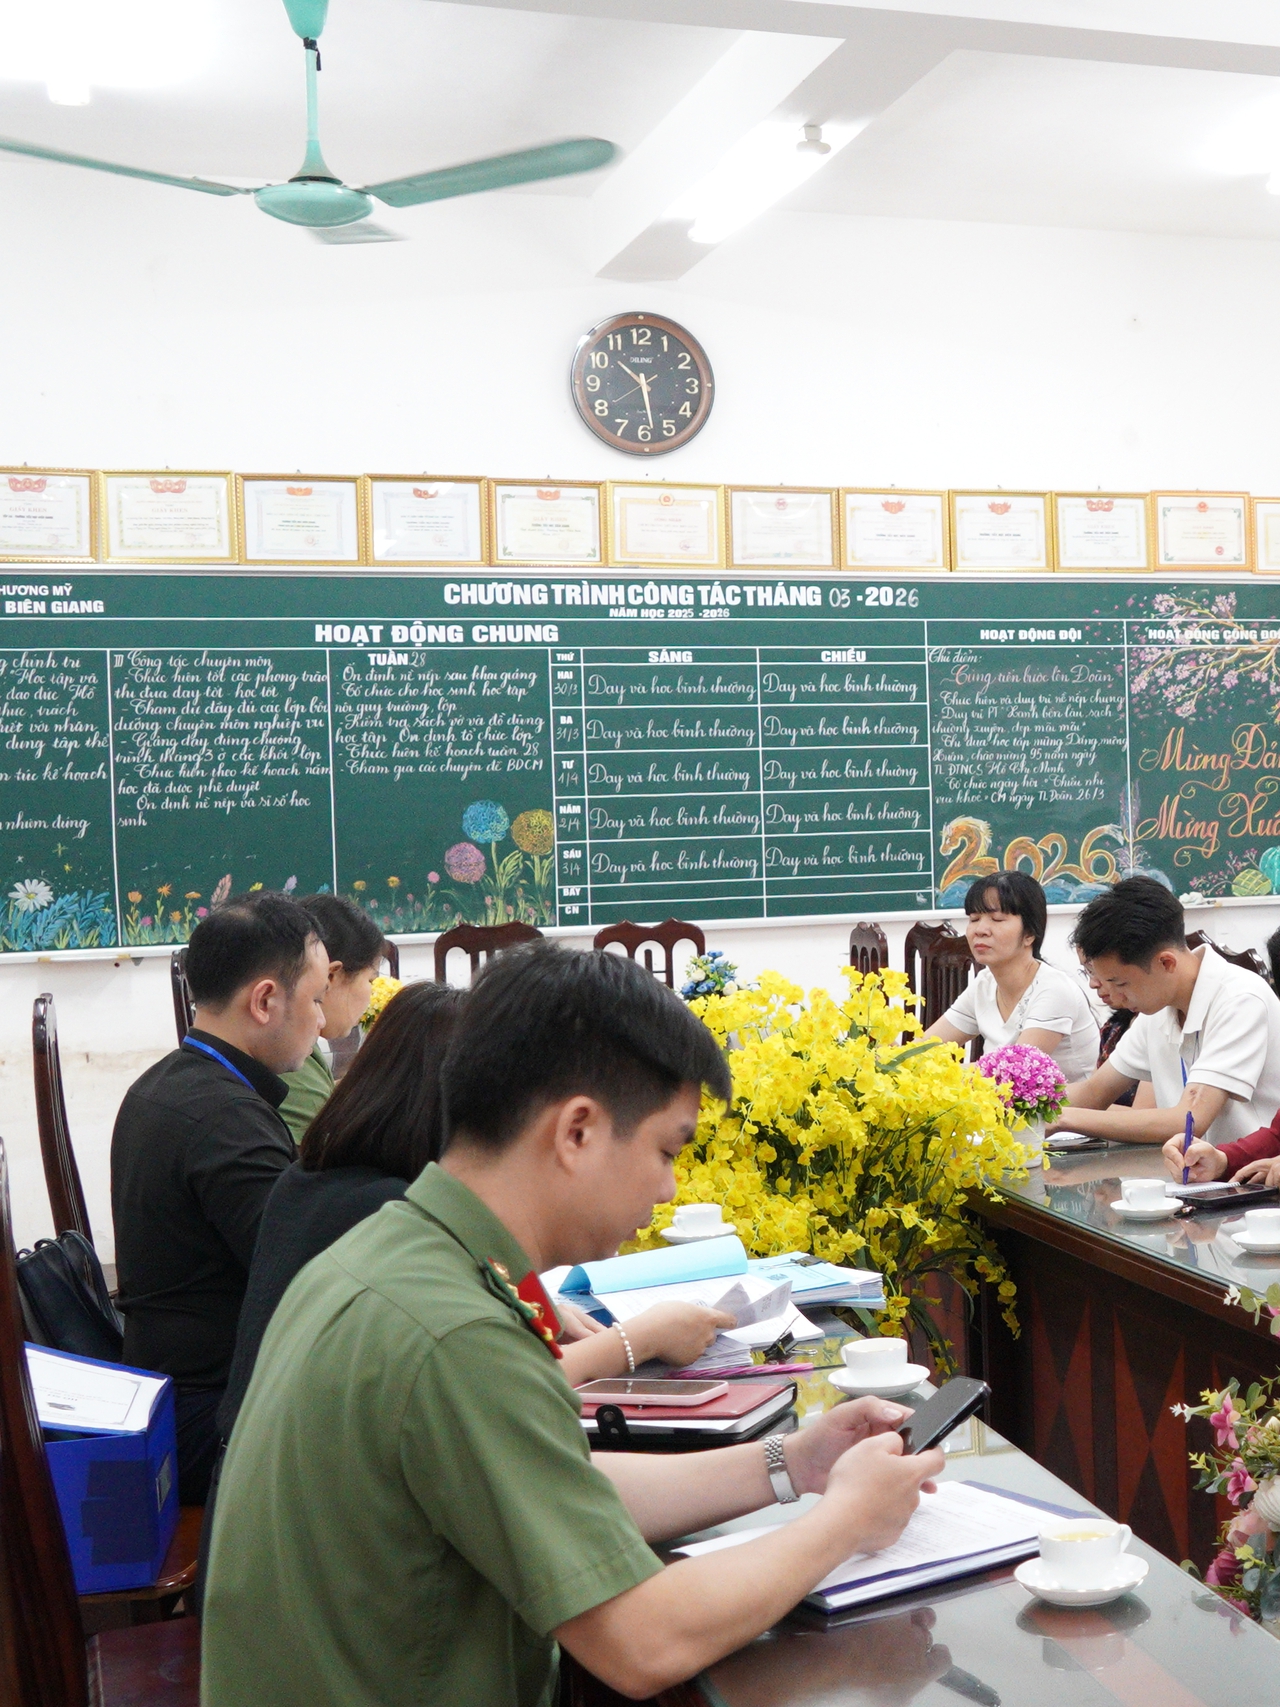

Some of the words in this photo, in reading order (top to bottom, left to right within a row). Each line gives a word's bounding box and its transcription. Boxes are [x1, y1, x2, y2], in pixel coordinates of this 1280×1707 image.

[607, 333, 622, 351] 11
[630, 328, 651, 345] 12
[661, 335, 668, 352] 1
[589, 351, 608, 369] 10
[677, 352, 691, 370] 2
[586, 374, 601, 392] 9
[685, 377, 699, 394] 3
[594, 399, 608, 417] 8
[678, 401, 692, 418] 4
[615, 418, 629, 436] 7
[637, 425, 651, 442] 6
[662, 419, 676, 437] 5
[52, 583, 73, 596] MỸ
[443, 582, 548, 605] CHƯƠNG
[551, 580, 625, 605] TRÌNH
[627, 581, 694, 605] CÔNG
[697, 581, 741, 606] TÁC
[743, 582, 822, 607] THÁNG
[5, 598, 46, 614] BIÊN
[51, 600, 104, 613] GIANG
[609, 607, 638, 617] NĂM
[640, 608, 665, 619] HỌC
[315, 624, 384, 647] HOẠT
[391, 621, 464, 647] ĐỘNG
[472, 624, 559, 643] CHUNG
[980, 629, 1015, 642] HOẠT
[1018, 628, 1056, 642] ĐỘNG
[1059, 628, 1082, 642] ĐỘI
[1149, 629, 1181, 642] HOẠT
[367, 650, 408, 666] TUẦN
[648, 649, 693, 663] SÁNG
[557, 671, 573, 680] HAI
[560, 715, 573, 725] BA
[562, 760, 574, 769] TƯ
[559, 804, 581, 815] NĂM
[563, 849, 582, 859] SÁU
